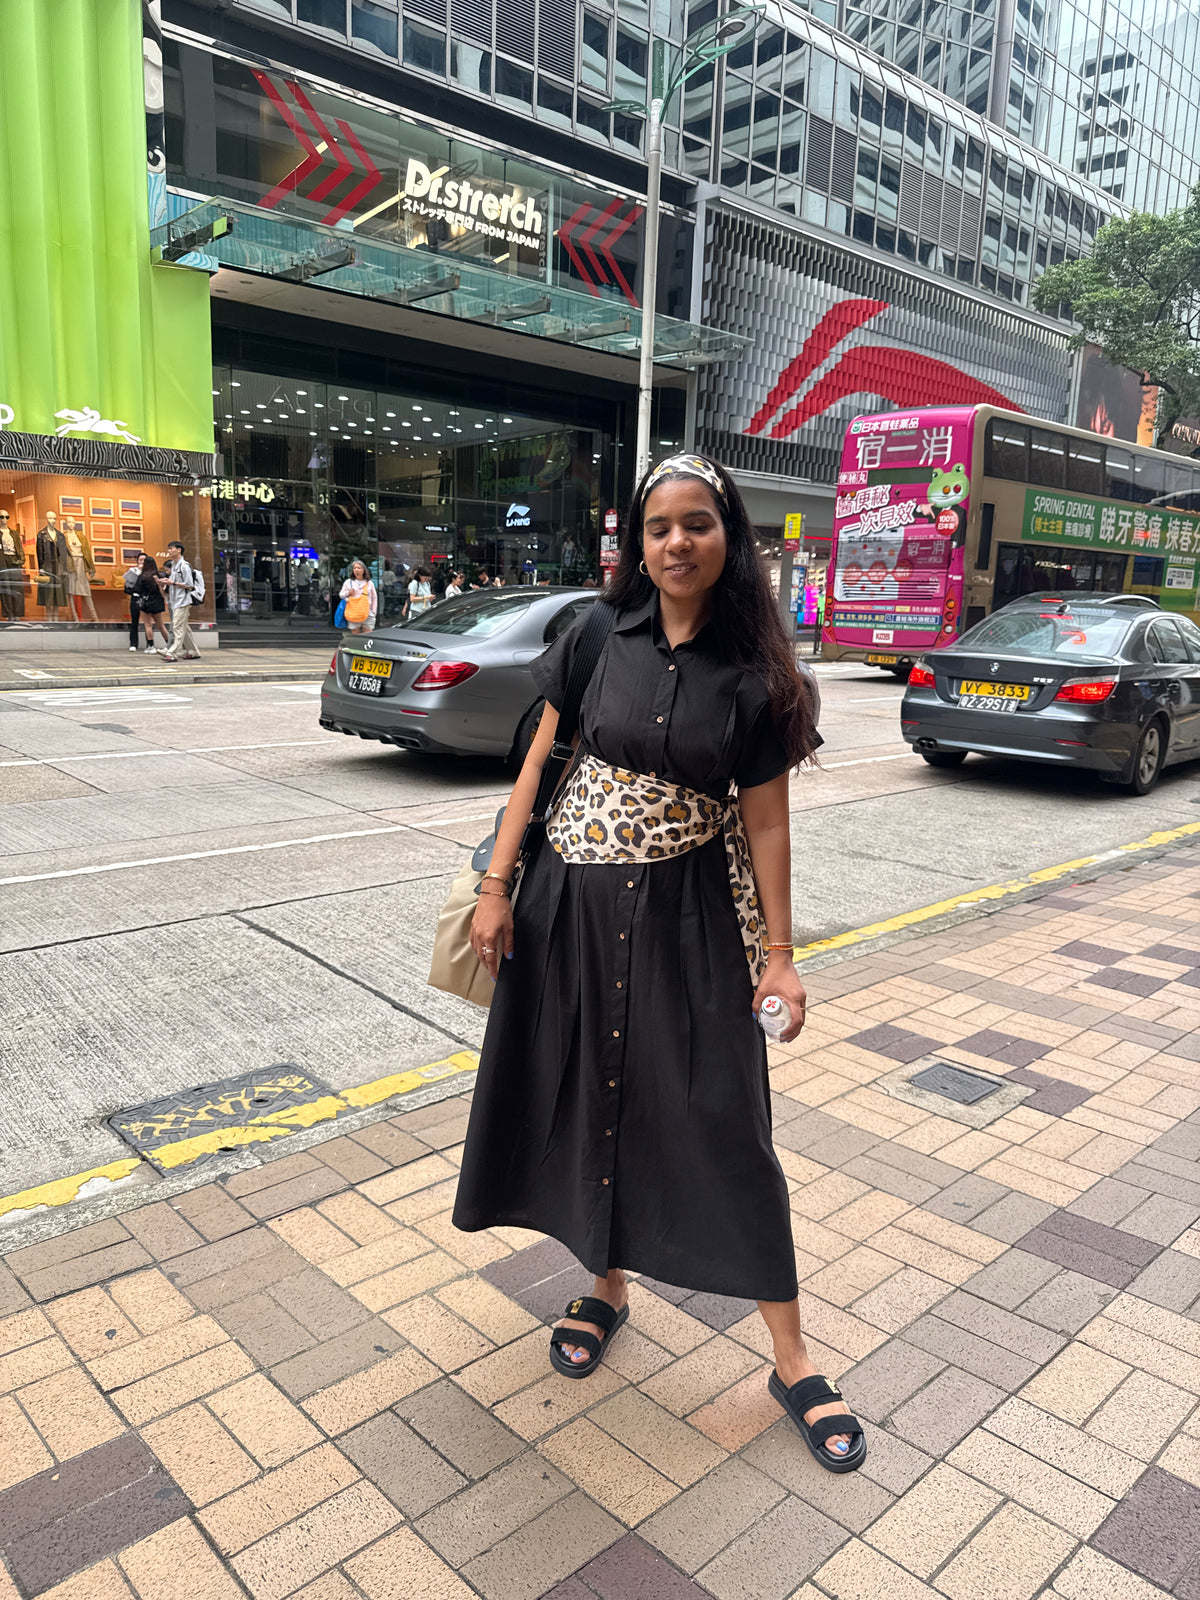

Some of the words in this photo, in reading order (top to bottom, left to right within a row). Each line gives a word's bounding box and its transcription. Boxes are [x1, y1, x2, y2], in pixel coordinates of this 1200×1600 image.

[405, 158, 543, 235] Dr.stretch
[403, 198, 474, 231] ストレッチ専門店
[475, 221, 505, 240] FROM
[506, 230, 539, 249] JAPAN
[856, 426, 953, 470] 宿一消
[836, 485, 891, 518] 醫便秘
[843, 500, 917, 535] 一次見效
[1033, 496, 1065, 515] SPRING
[1065, 501, 1095, 520] DENTAL
[506, 517, 530, 527] LI-NING
[1099, 506, 1163, 549] 睇牙驚痛
[367, 661, 390, 675] 3703
[965, 682, 983, 694] VY
[988, 684, 1025, 698] 3833
